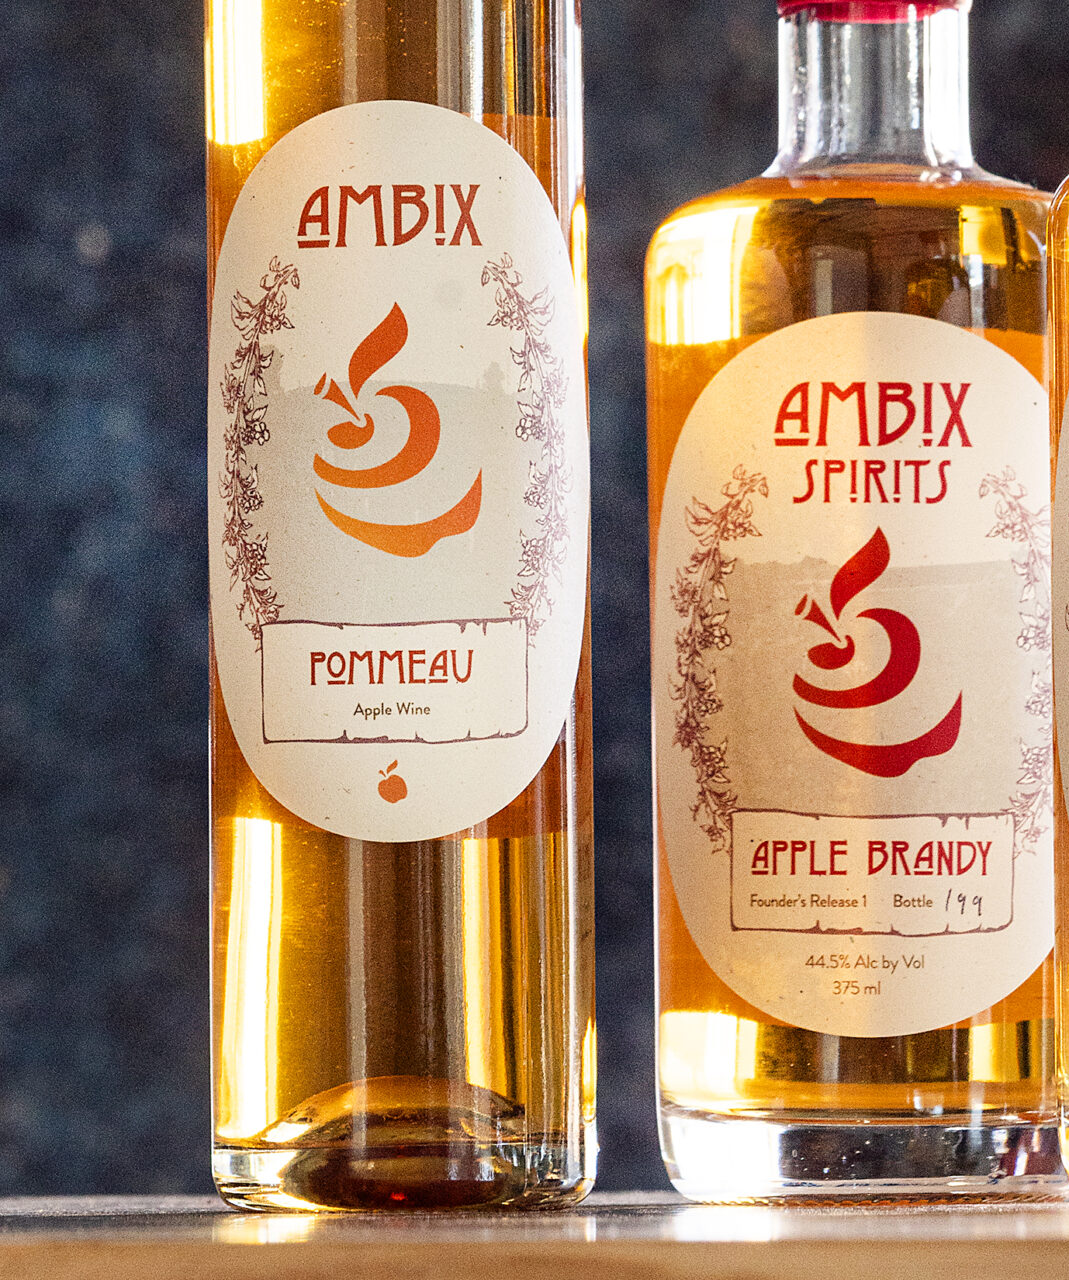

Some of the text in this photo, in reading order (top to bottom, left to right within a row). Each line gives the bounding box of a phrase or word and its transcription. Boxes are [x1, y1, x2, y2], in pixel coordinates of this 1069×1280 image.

[296, 184, 483, 248] AMBIX
[773, 380, 972, 448] AMBIX
[792, 458, 951, 505] SPIRITS
[310, 649, 474, 686] POMMEAU
[352, 701, 431, 721] Apple Wine
[750, 838, 992, 876] APPLE BRANDY
[749, 892, 867, 908] Founder's Release 1
[892, 893, 934, 908] Bottle
[804, 953, 925, 975] 44.5% Alc by Vol
[832, 980, 881, 996] 375 ml
